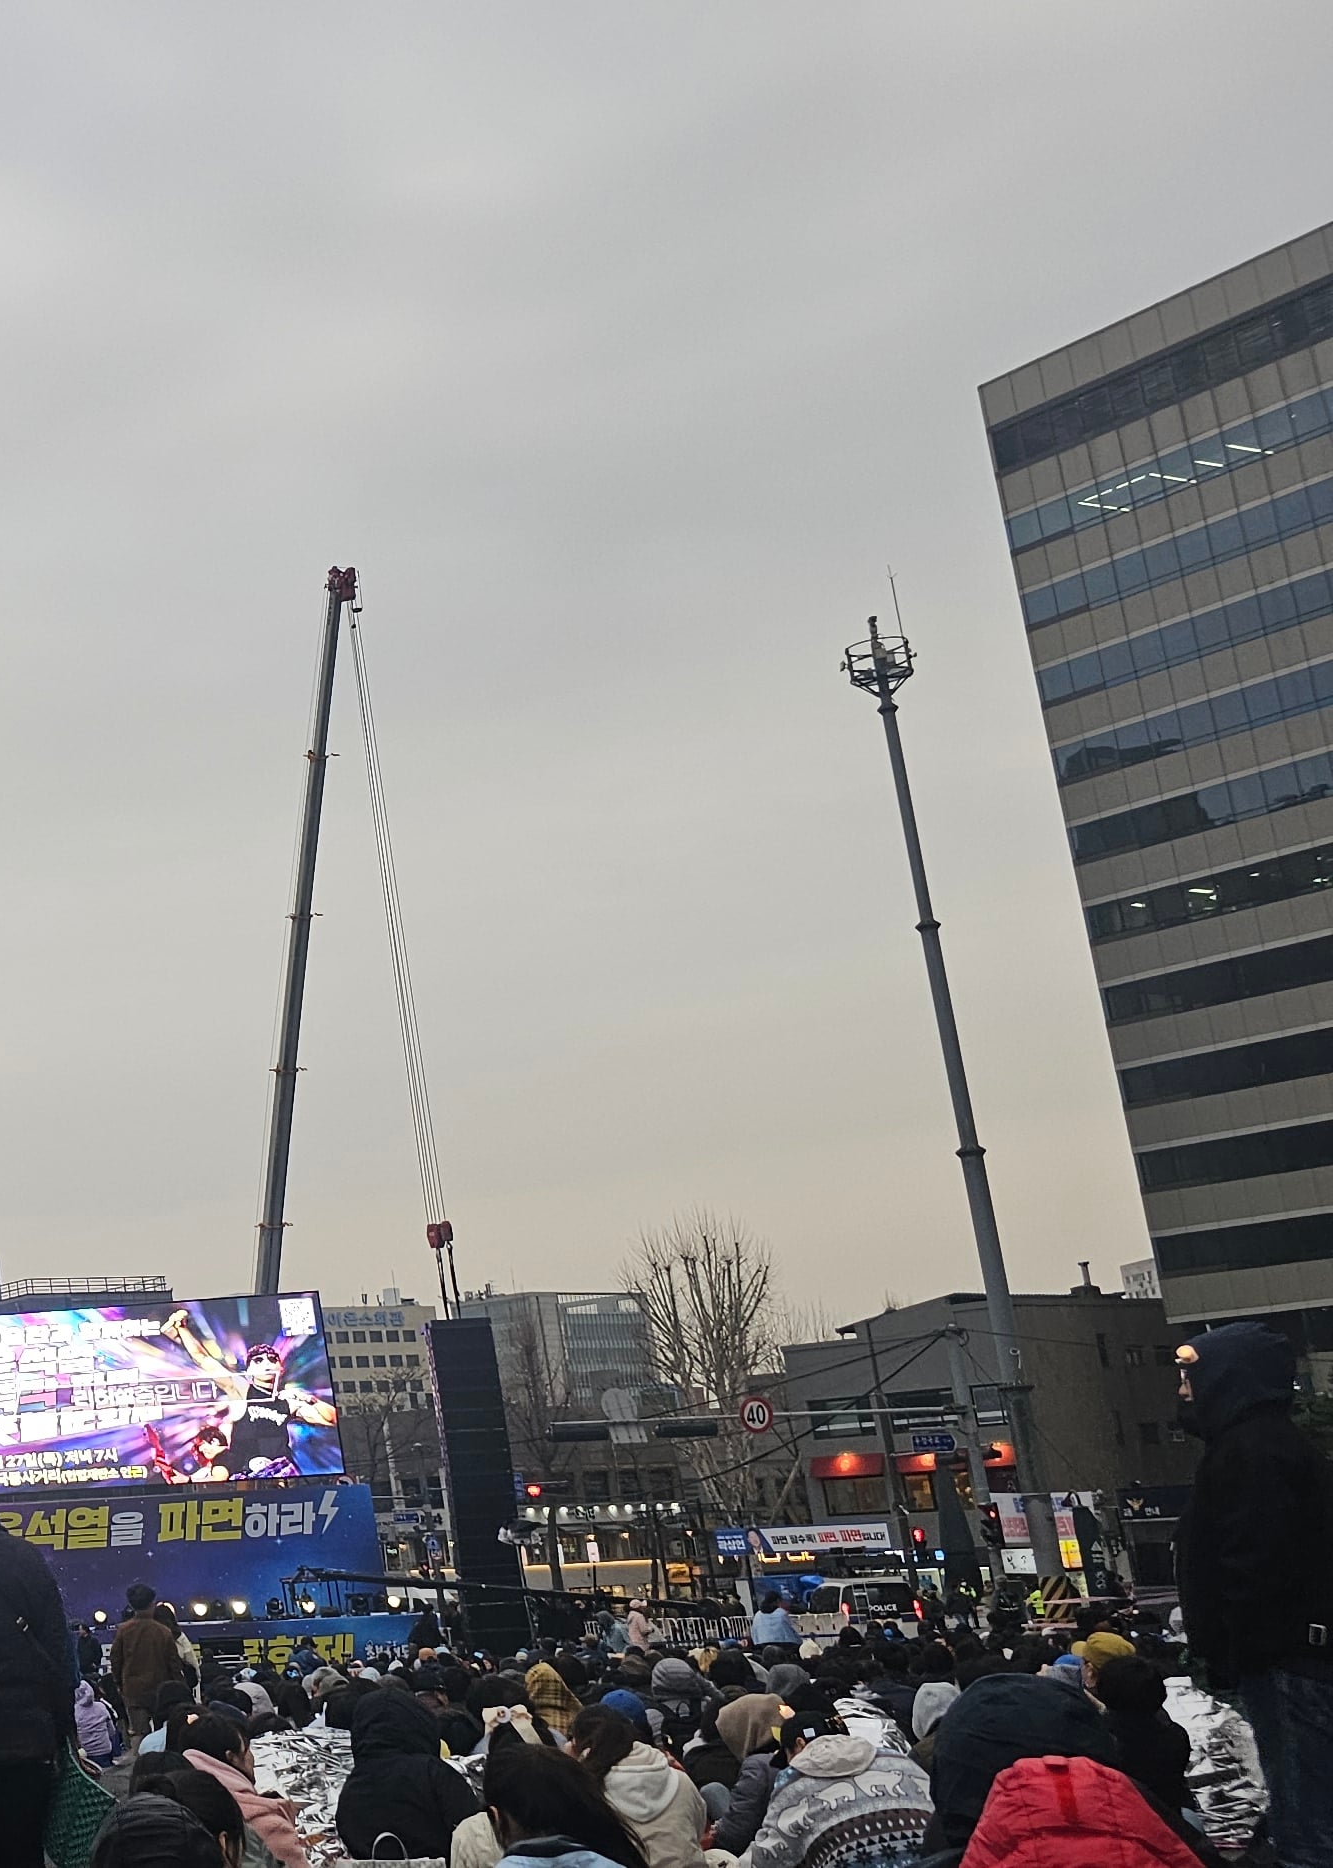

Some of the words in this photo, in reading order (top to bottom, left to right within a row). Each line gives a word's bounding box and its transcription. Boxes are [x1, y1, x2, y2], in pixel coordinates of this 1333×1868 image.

[323, 1311, 405, 1327] 이온스회관
[746, 1404, 766, 1425] 40
[157, 1497, 316, 1542] 파면하라
